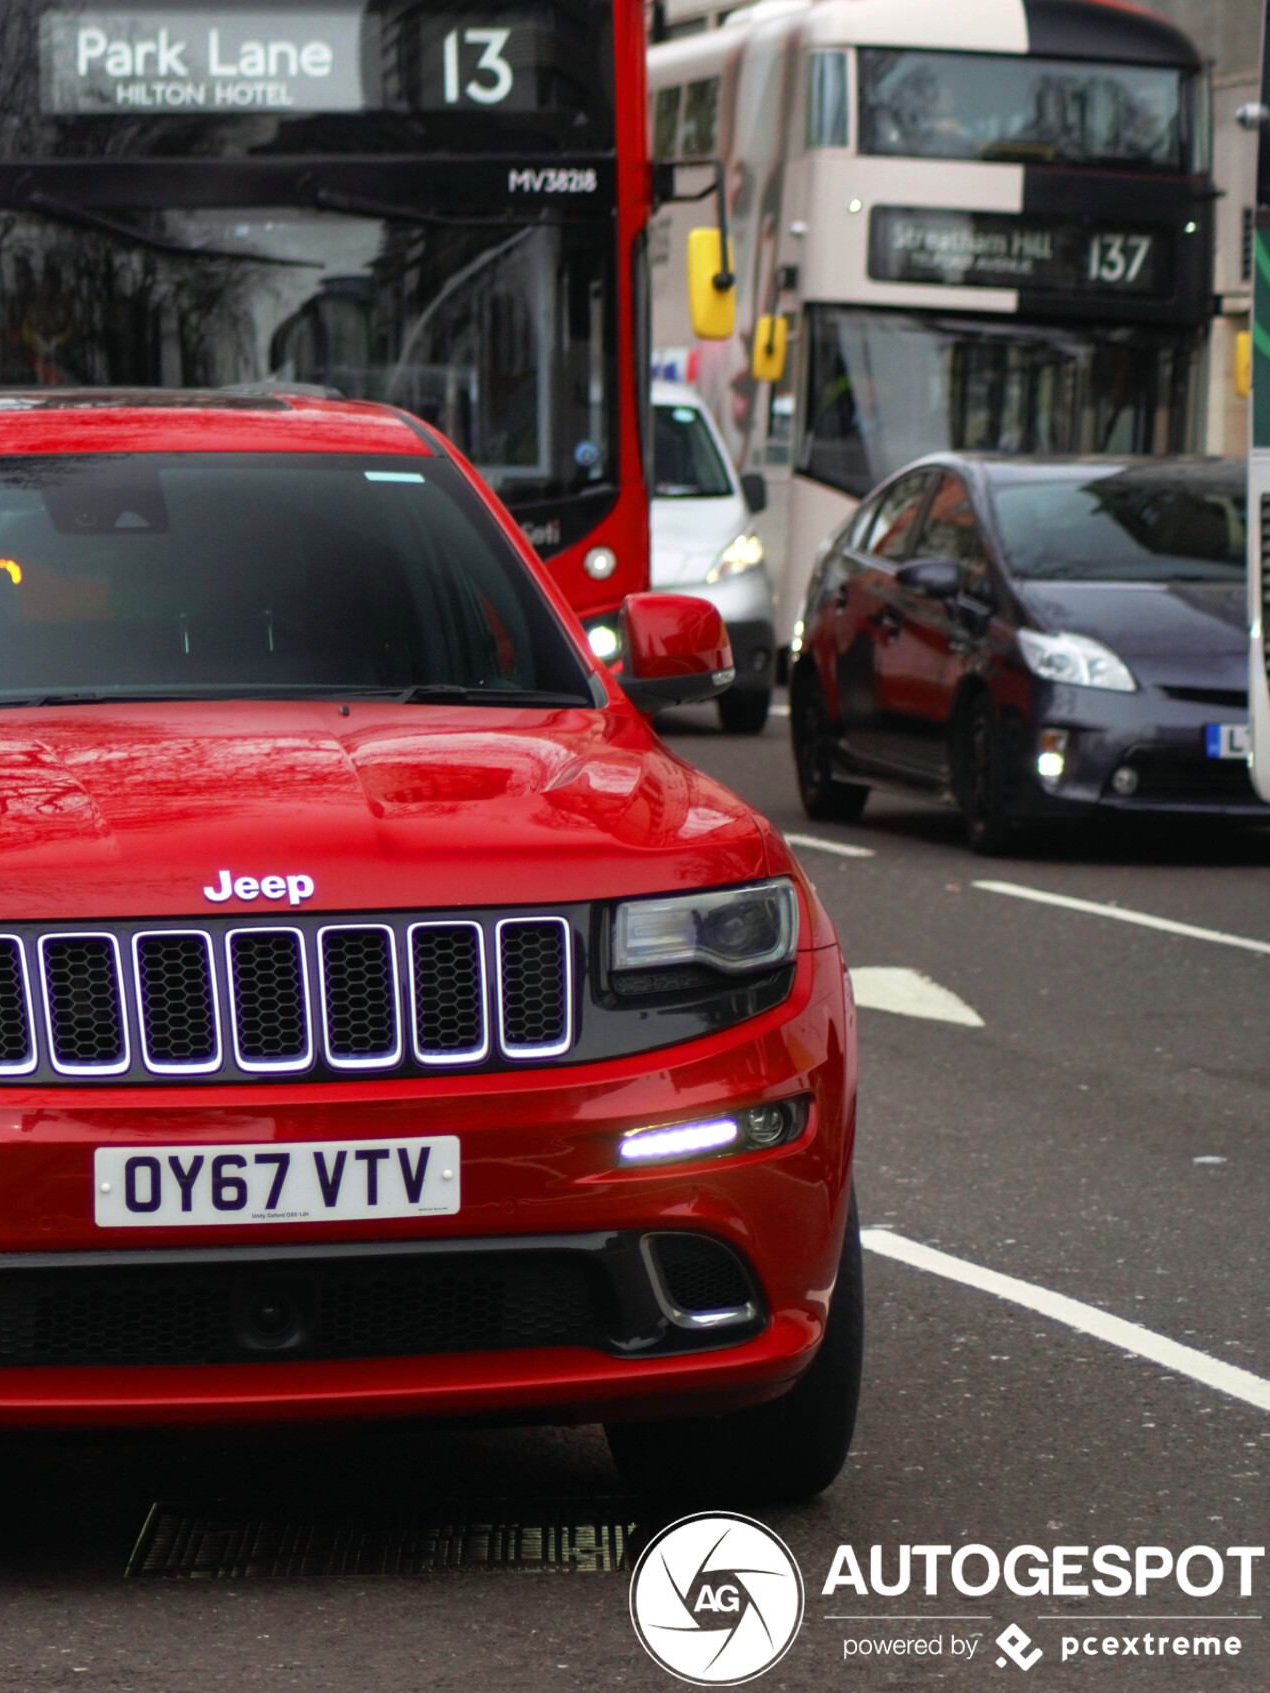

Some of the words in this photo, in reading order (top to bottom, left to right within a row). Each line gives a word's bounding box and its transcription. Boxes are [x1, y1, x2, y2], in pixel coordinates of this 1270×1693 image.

[77, 27, 188, 77] Park
[209, 27, 333, 77] Lane
[444, 27, 513, 104] 13
[116, 82, 205, 105] HILTON
[215, 82, 294, 106] HOTEL
[508, 168, 597, 193] MV38218
[1011, 230, 1053, 259] Hill
[1088, 234, 1152, 282] 137
[203, 870, 314, 905] Jeep
[124, 1153, 290, 1213] OY67
[313, 1146, 431, 1208] VTV
